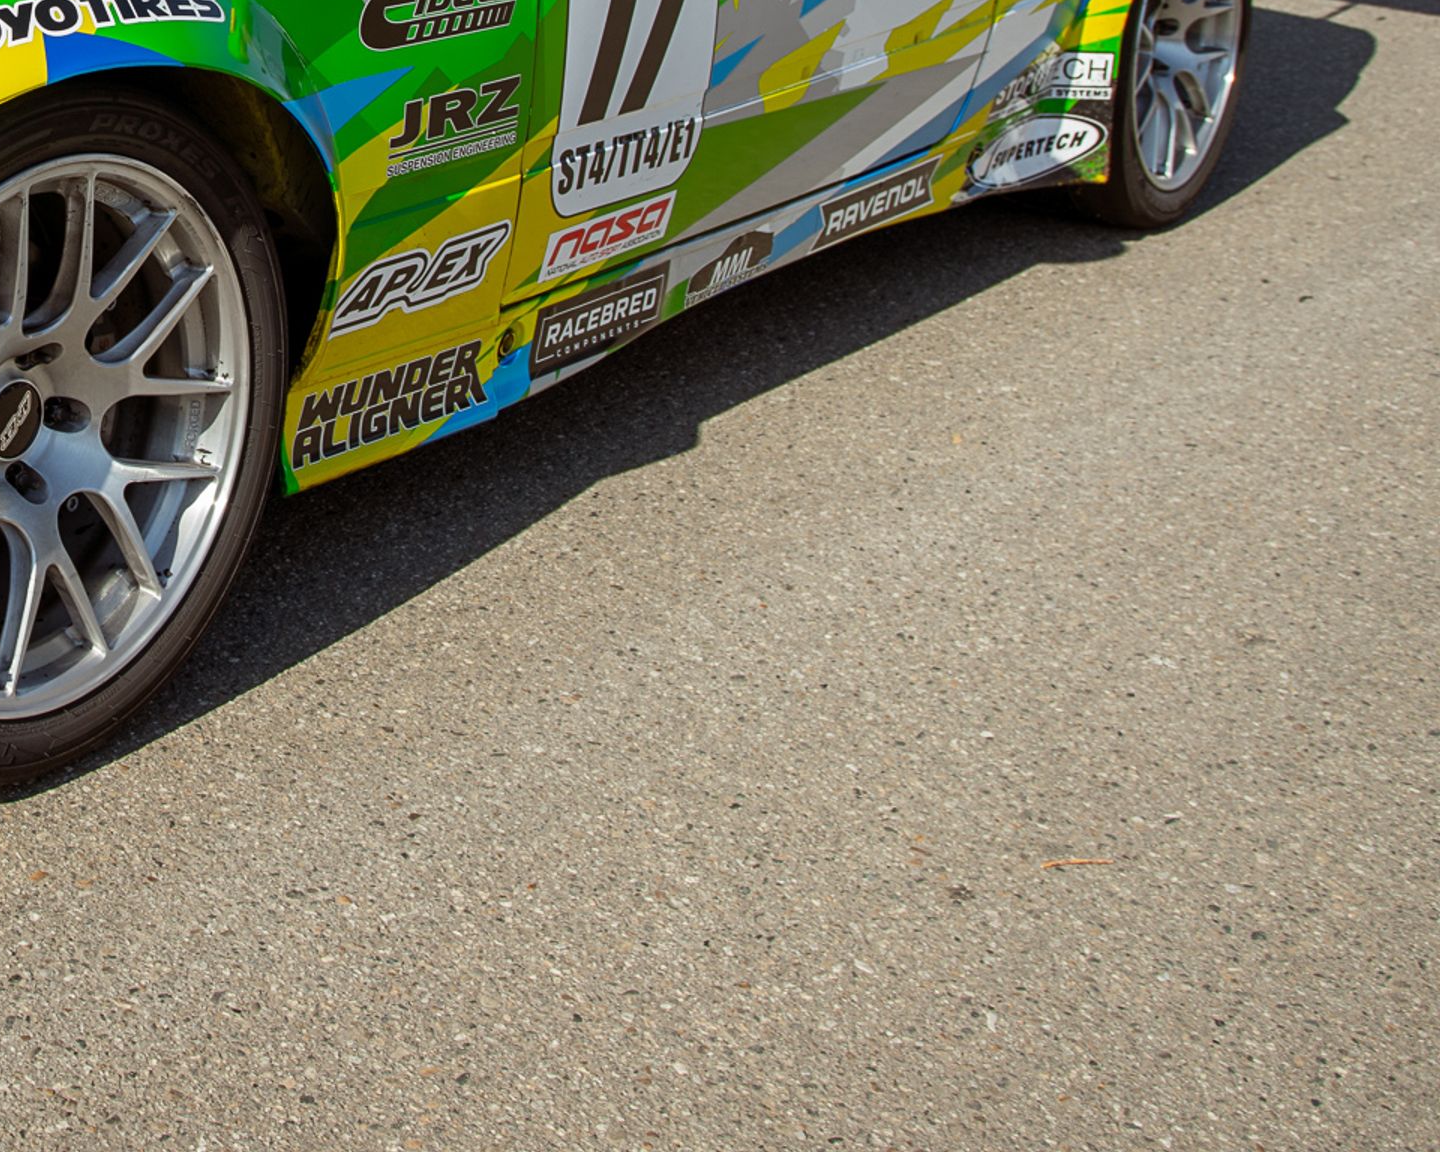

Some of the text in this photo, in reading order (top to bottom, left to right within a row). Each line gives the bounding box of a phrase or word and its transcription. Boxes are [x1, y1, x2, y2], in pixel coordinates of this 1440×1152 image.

[389, 74, 521, 149] JRZ
[387, 131, 517, 178] SUSPENSION ENGINEERING
[558, 118, 696, 195] ST4/TT4/E1
[991, 131, 1088, 169] SUPERTECH
[825, 176, 926, 236] RAVENOL
[332, 228, 502, 329] APEX
[544, 288, 657, 347] RACEBRED
[556, 320, 639, 357] COMPONENTS
[297, 338, 486, 432] WUNDER
[292, 374, 472, 471] ALIGNER
